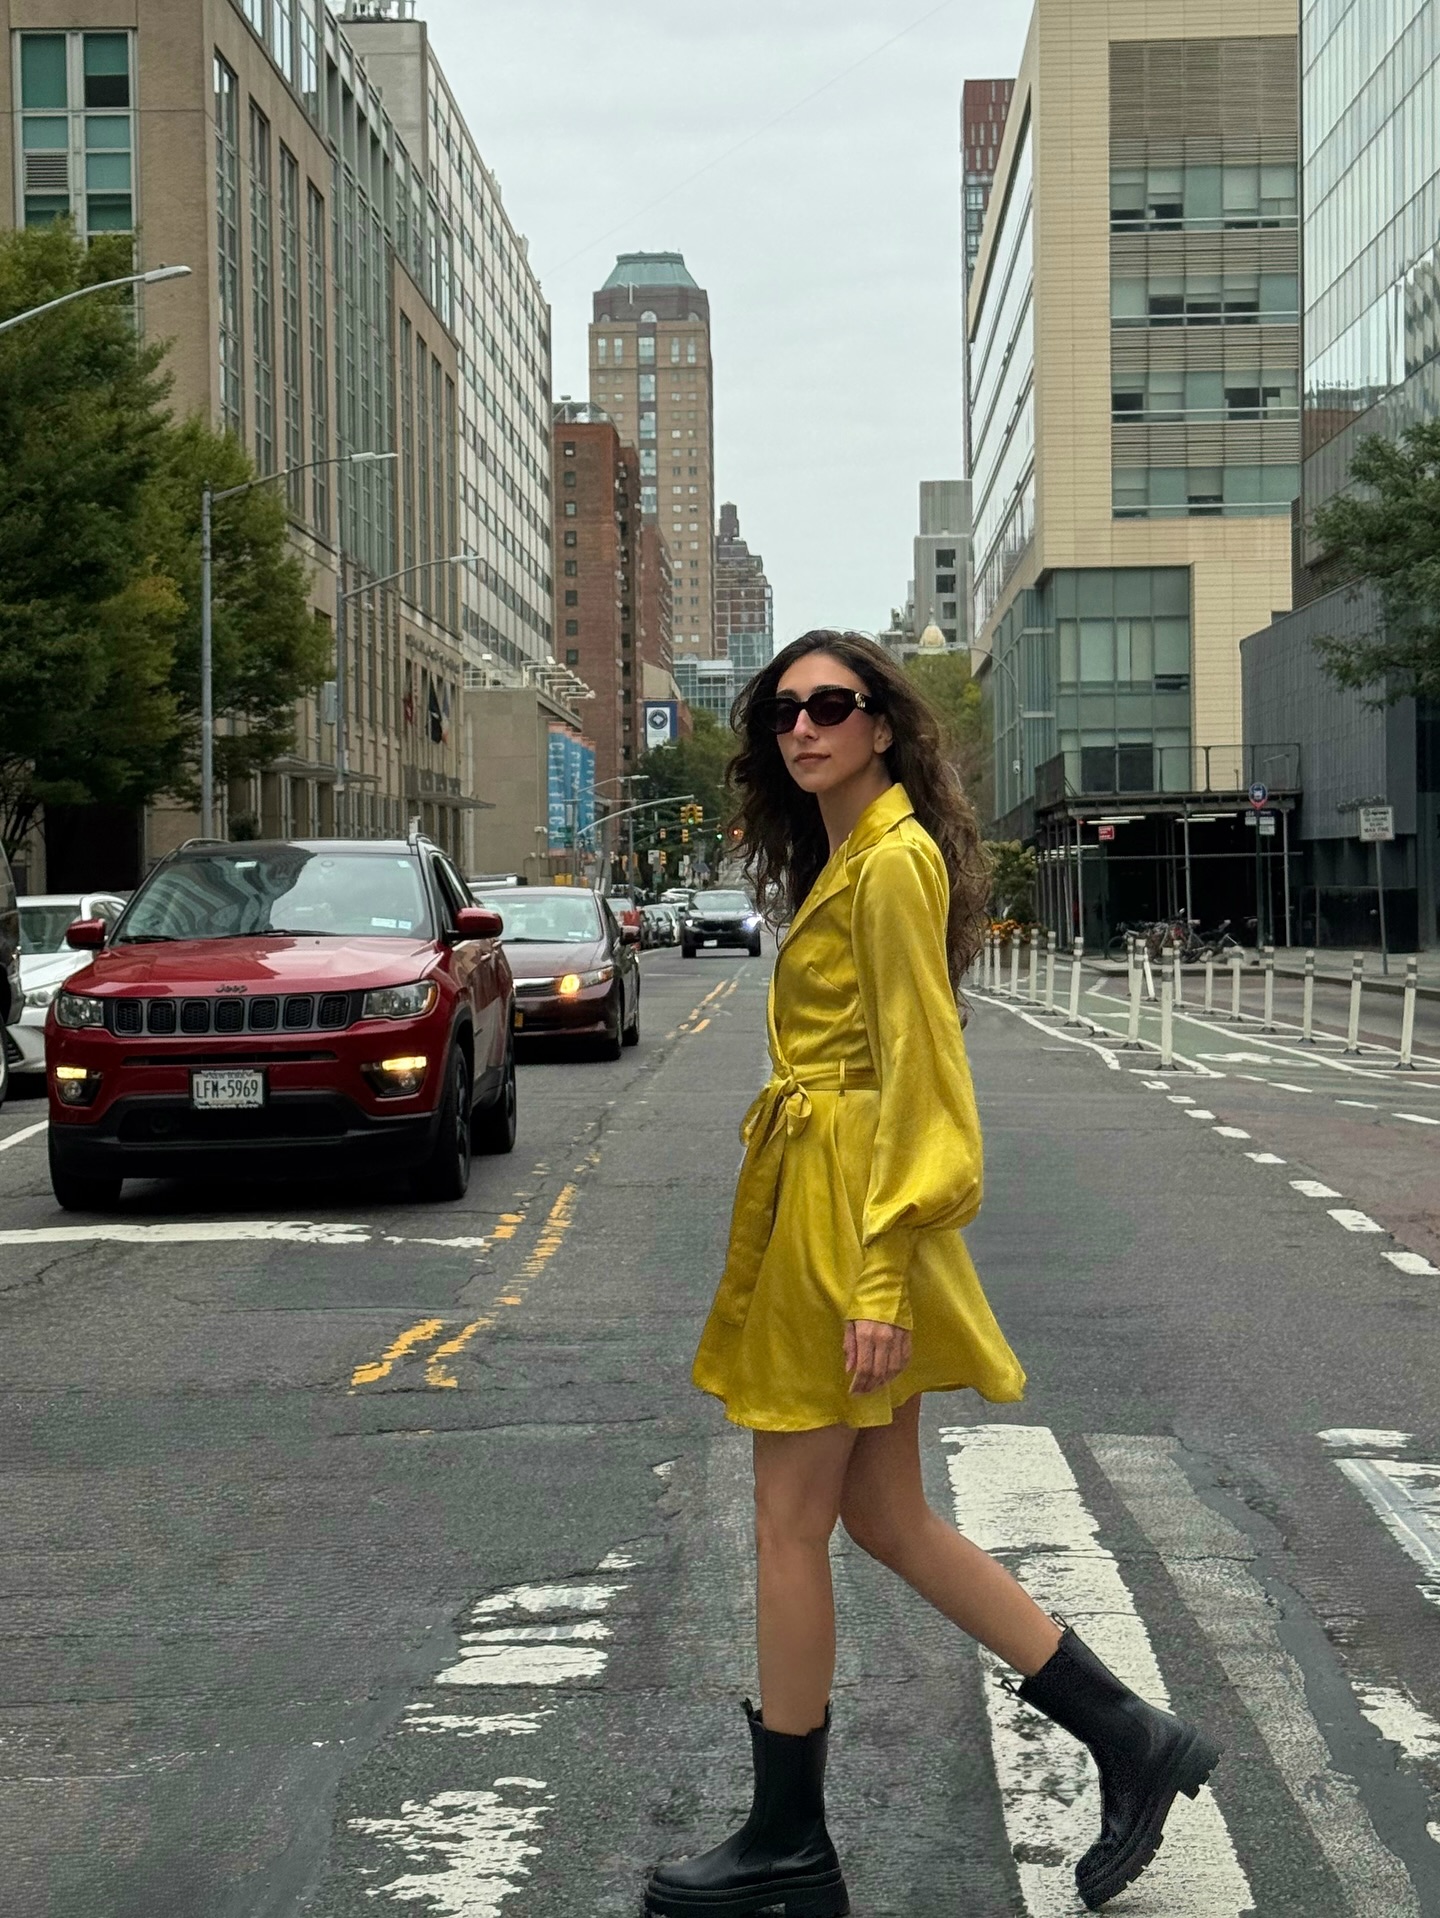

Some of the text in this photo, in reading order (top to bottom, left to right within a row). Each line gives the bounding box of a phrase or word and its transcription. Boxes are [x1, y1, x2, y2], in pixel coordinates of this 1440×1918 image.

[549, 742, 565, 840] CITY TECH
[227, 1080, 259, 1098] 5969
